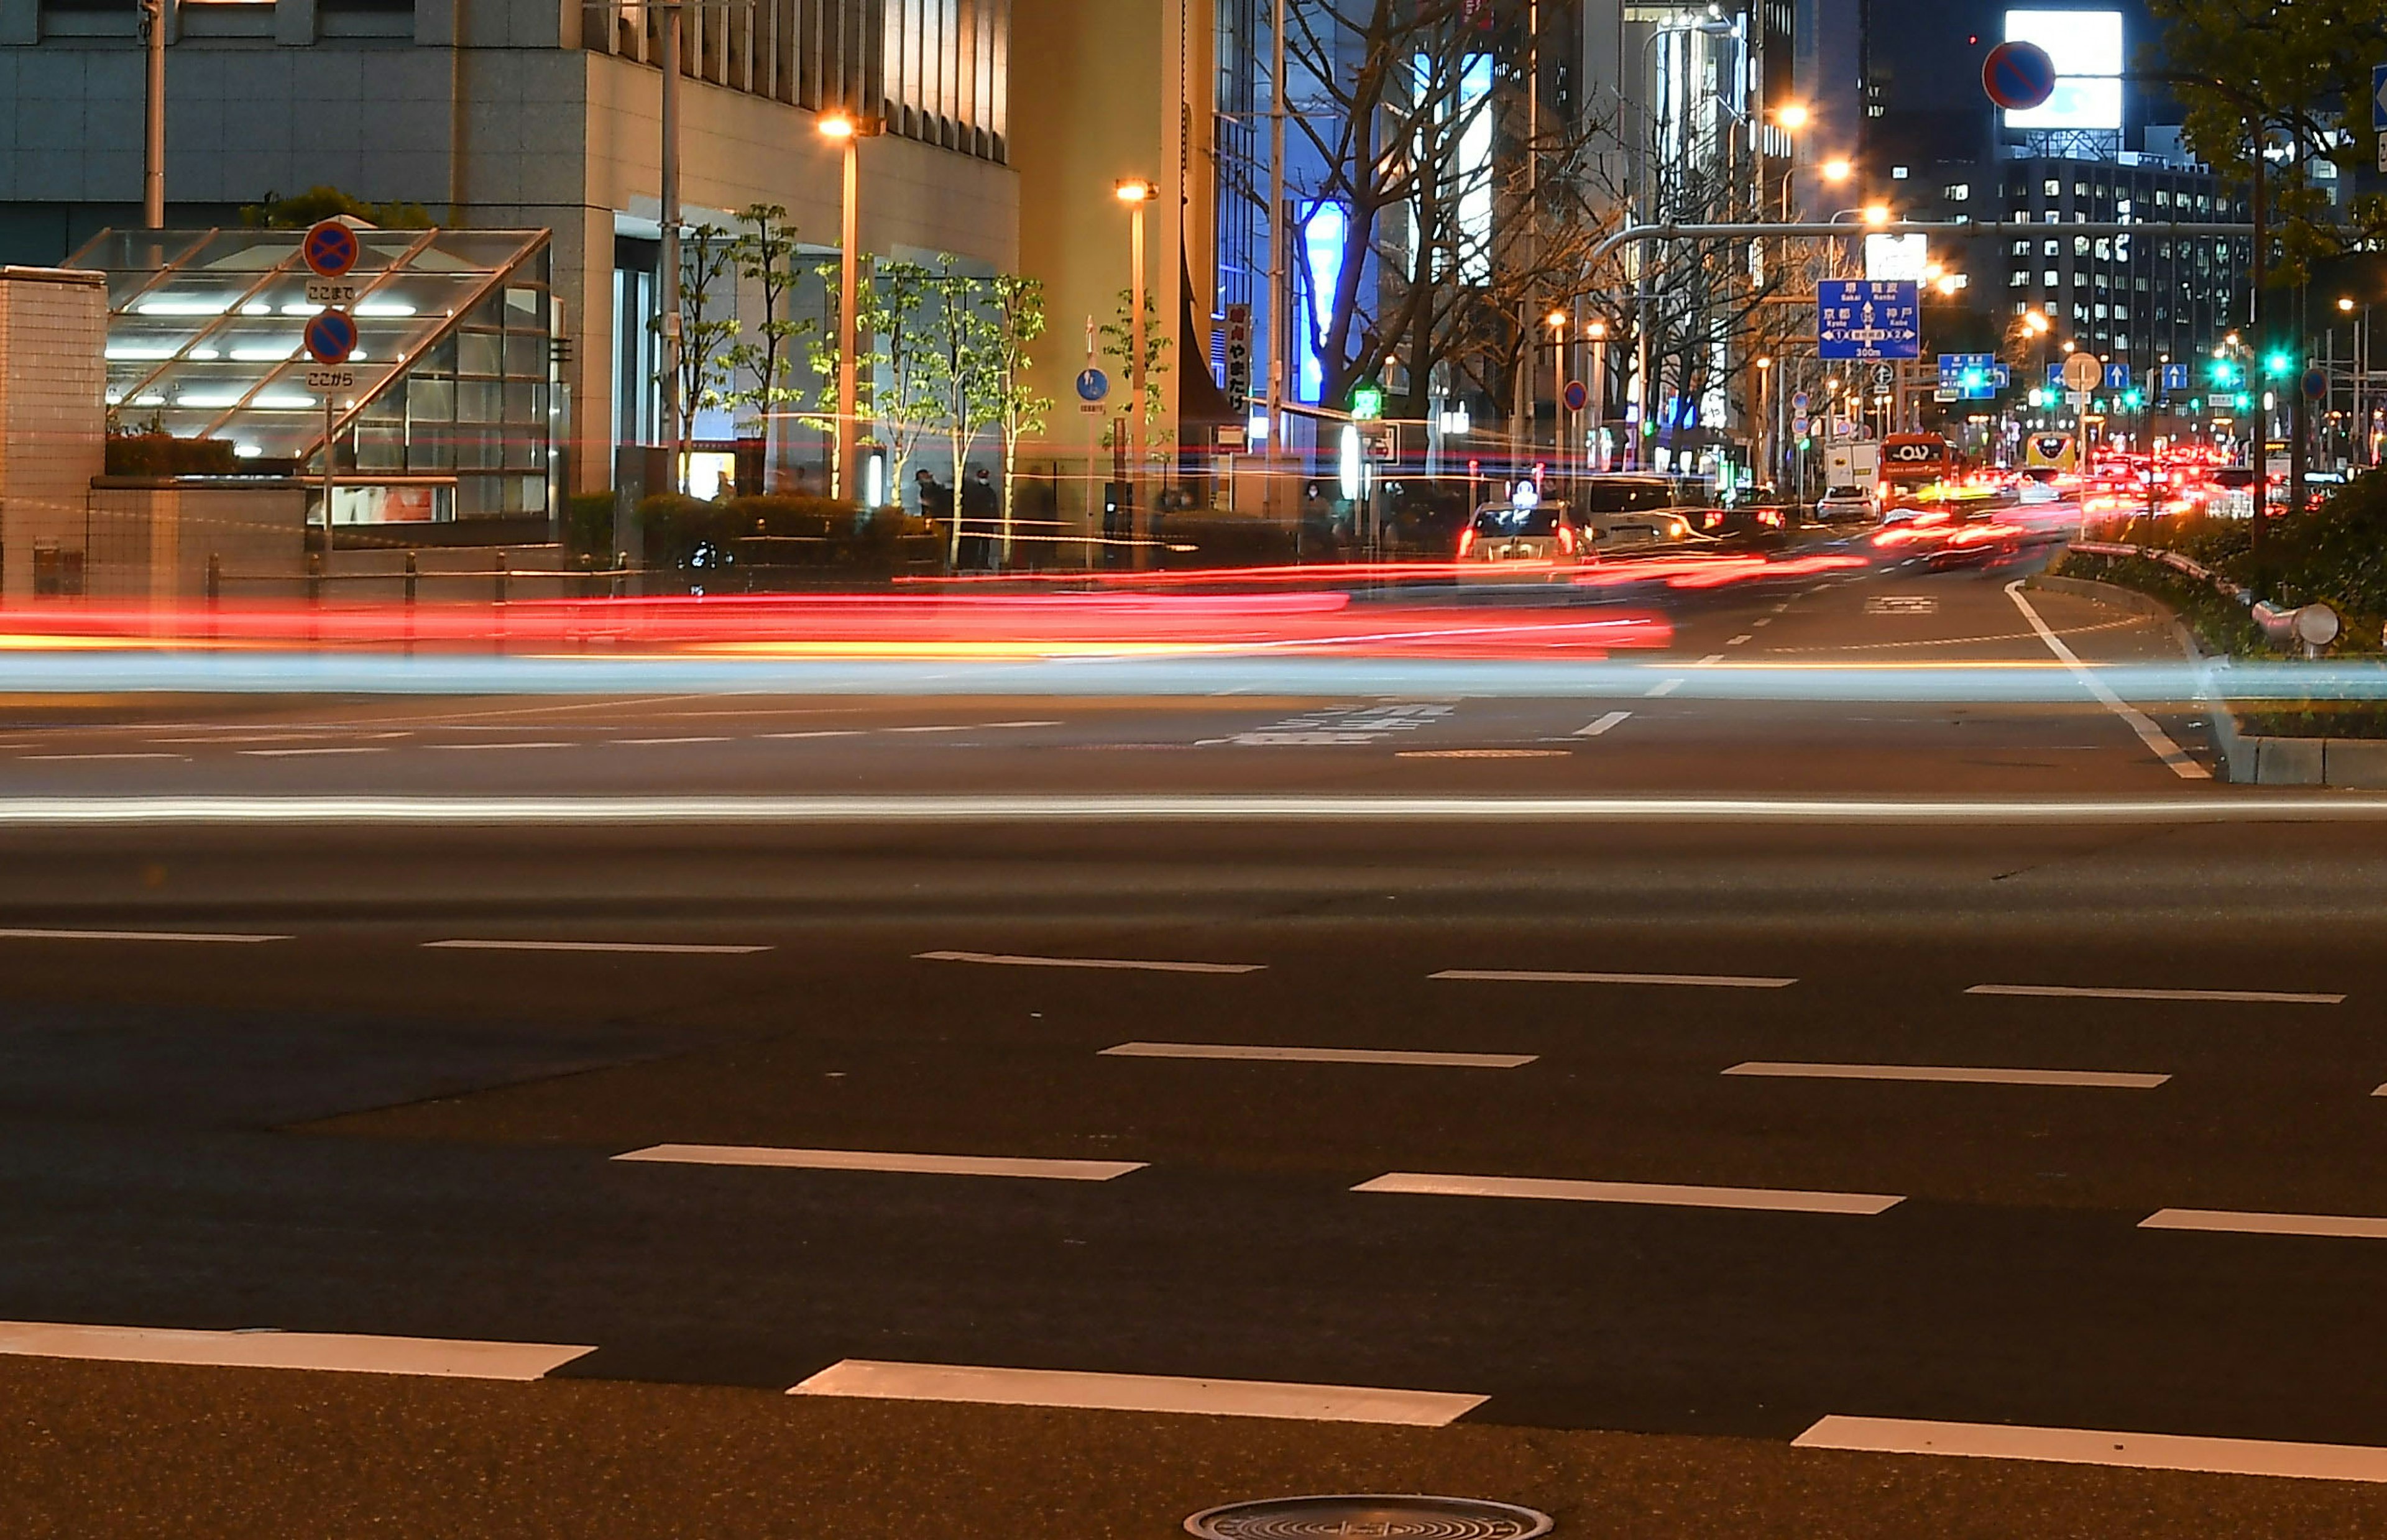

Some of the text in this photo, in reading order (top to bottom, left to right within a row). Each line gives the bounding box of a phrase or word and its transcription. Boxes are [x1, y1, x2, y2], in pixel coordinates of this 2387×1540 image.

[308, 286, 354, 300] ここまで
[1824, 307, 1913, 320] 京都 神戸
[1856, 348, 1881, 357] 300m
[308, 372, 353, 387] ここから
